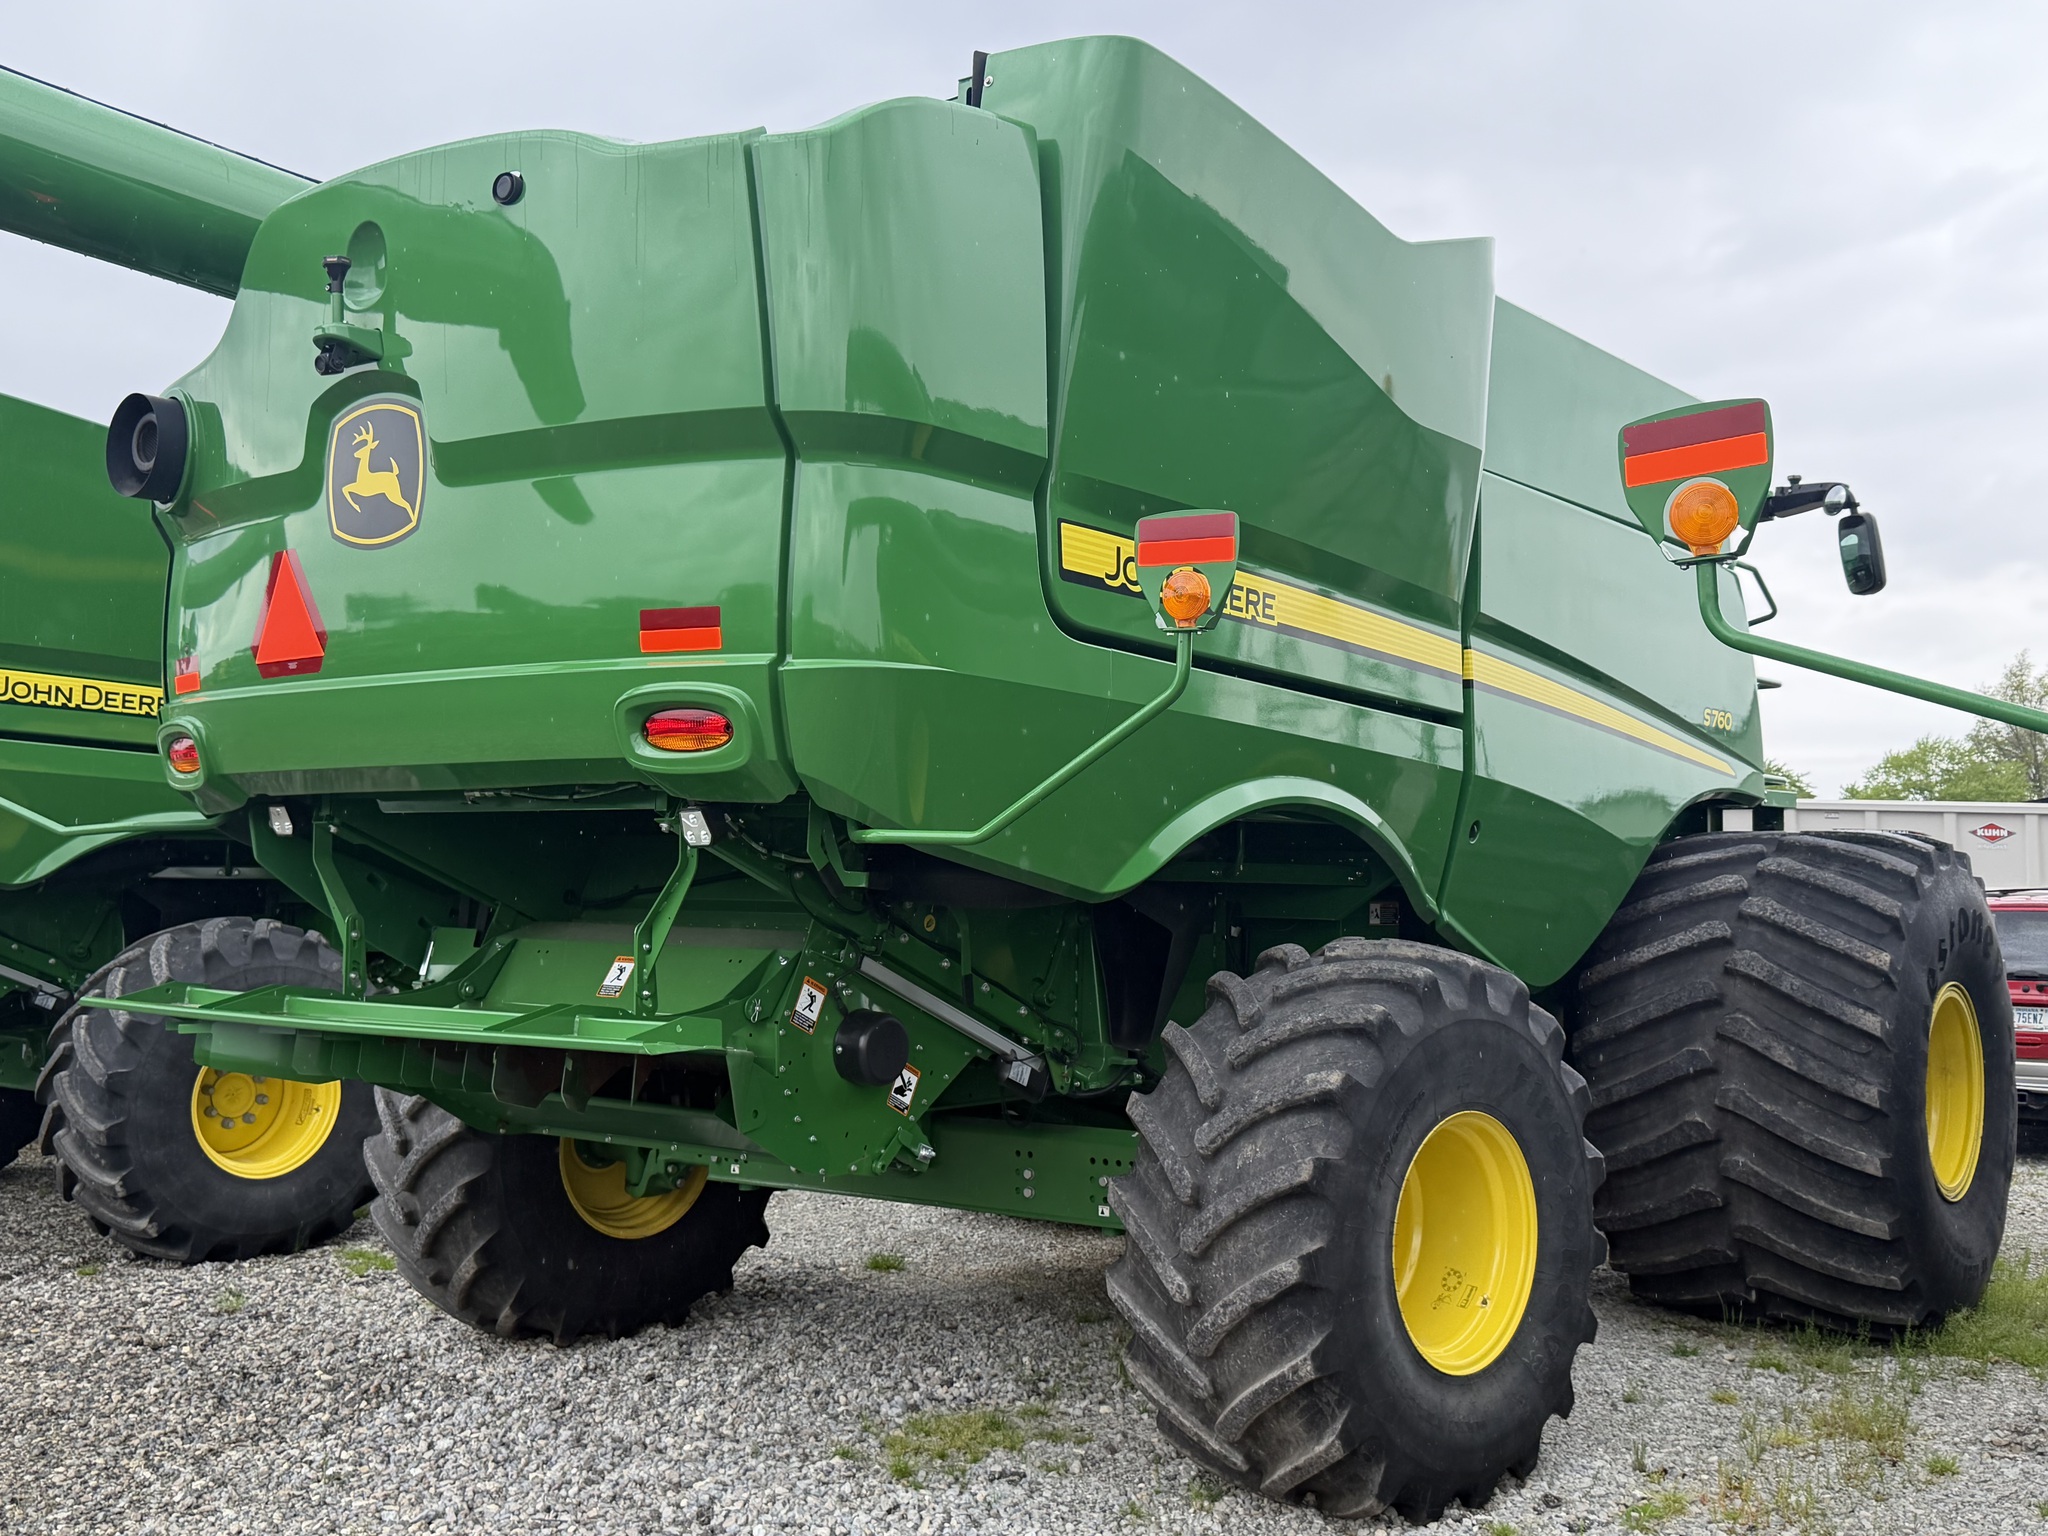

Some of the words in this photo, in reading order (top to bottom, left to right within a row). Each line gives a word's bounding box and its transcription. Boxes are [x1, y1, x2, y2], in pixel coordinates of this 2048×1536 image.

[1104, 545, 1140, 587] JO
[1226, 584, 1277, 622] ERE
[0, 675, 74, 704] JOHN
[1703, 708, 1732, 731] S760
[1977, 828, 2008, 837] KUHN
